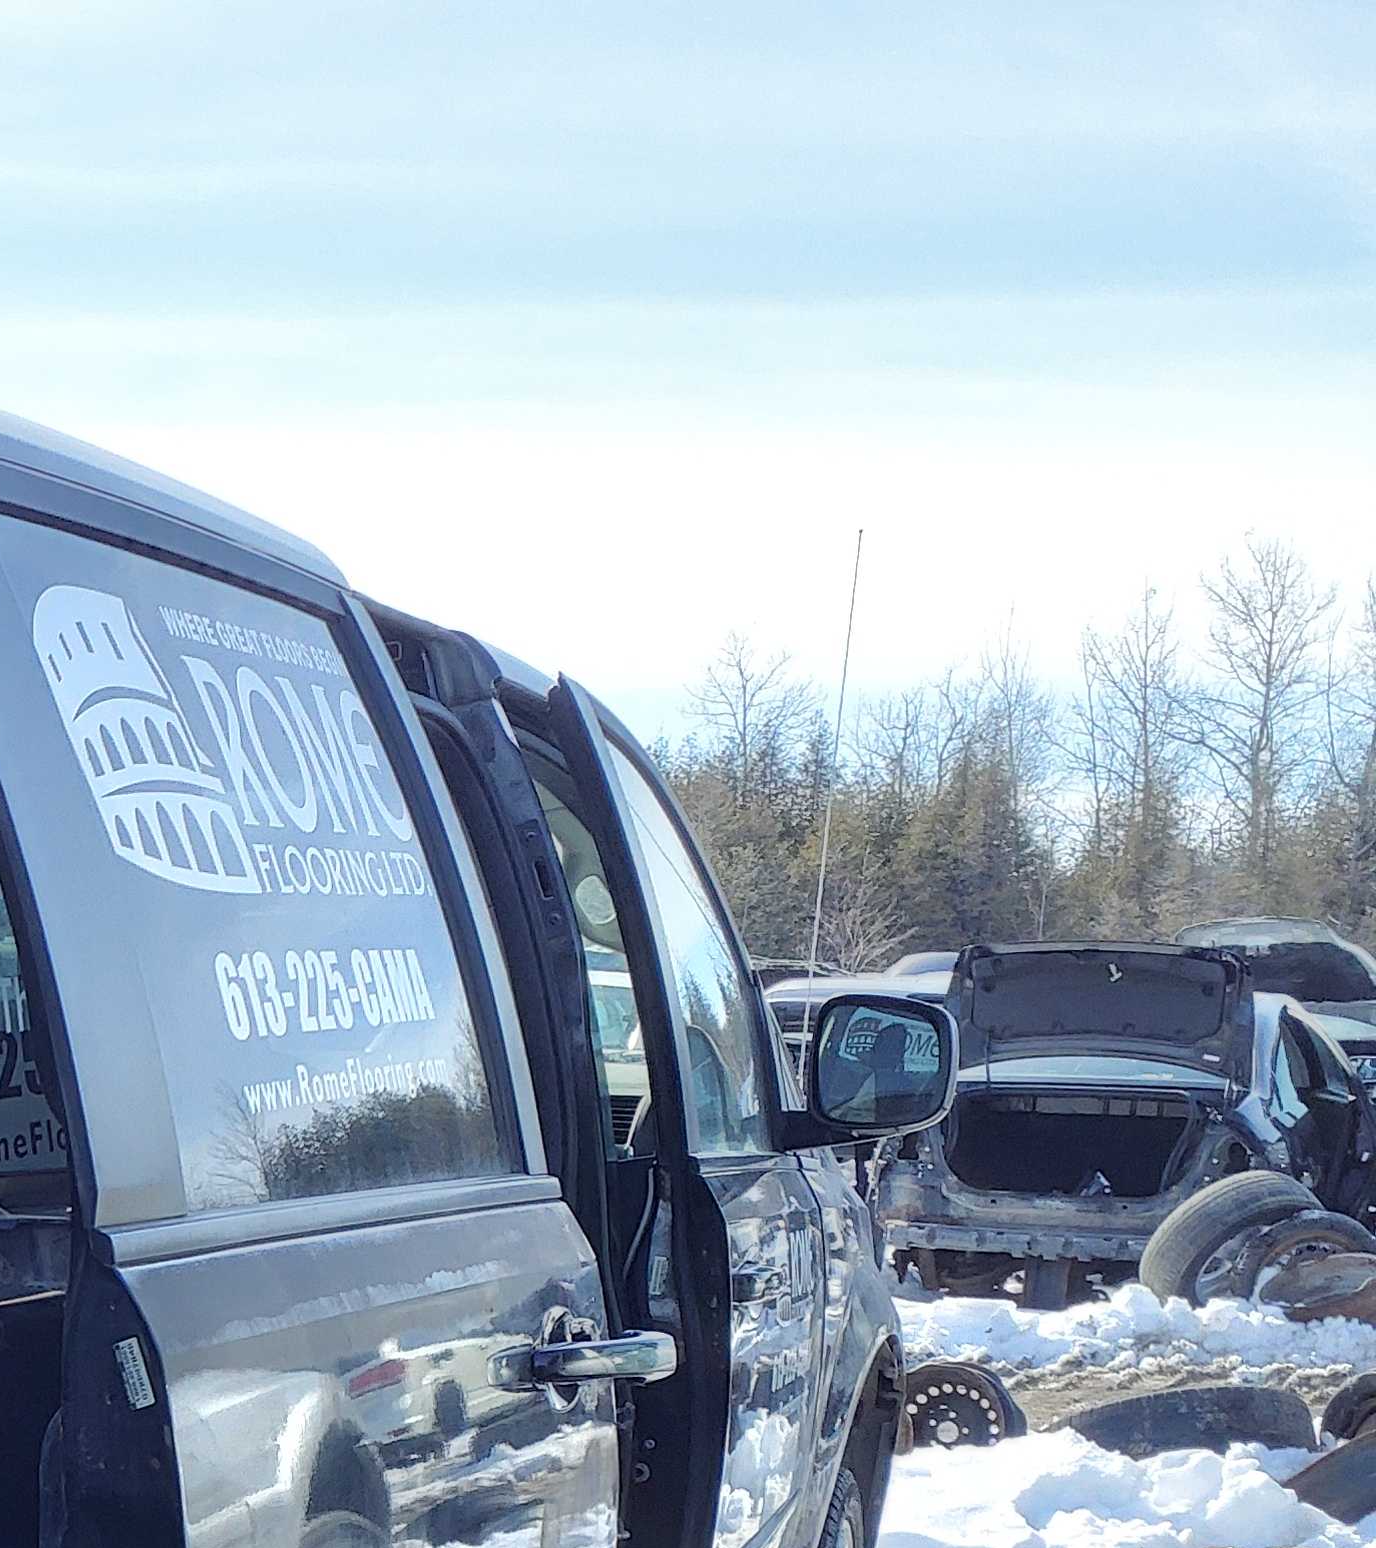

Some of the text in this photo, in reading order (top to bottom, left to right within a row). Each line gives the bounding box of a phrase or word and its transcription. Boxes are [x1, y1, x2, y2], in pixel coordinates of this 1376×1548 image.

[157, 605, 219, 646] WHERE
[215, 620, 263, 657] GREAT
[260, 631, 313, 670] FLOORS
[179, 654, 413, 842] ROME
[251, 843, 437, 898] FLOORING LTD.
[214, 948, 436, 1041] 613-225-CAMA
[243, 1054, 449, 1115] www.RomeFlooring.com
